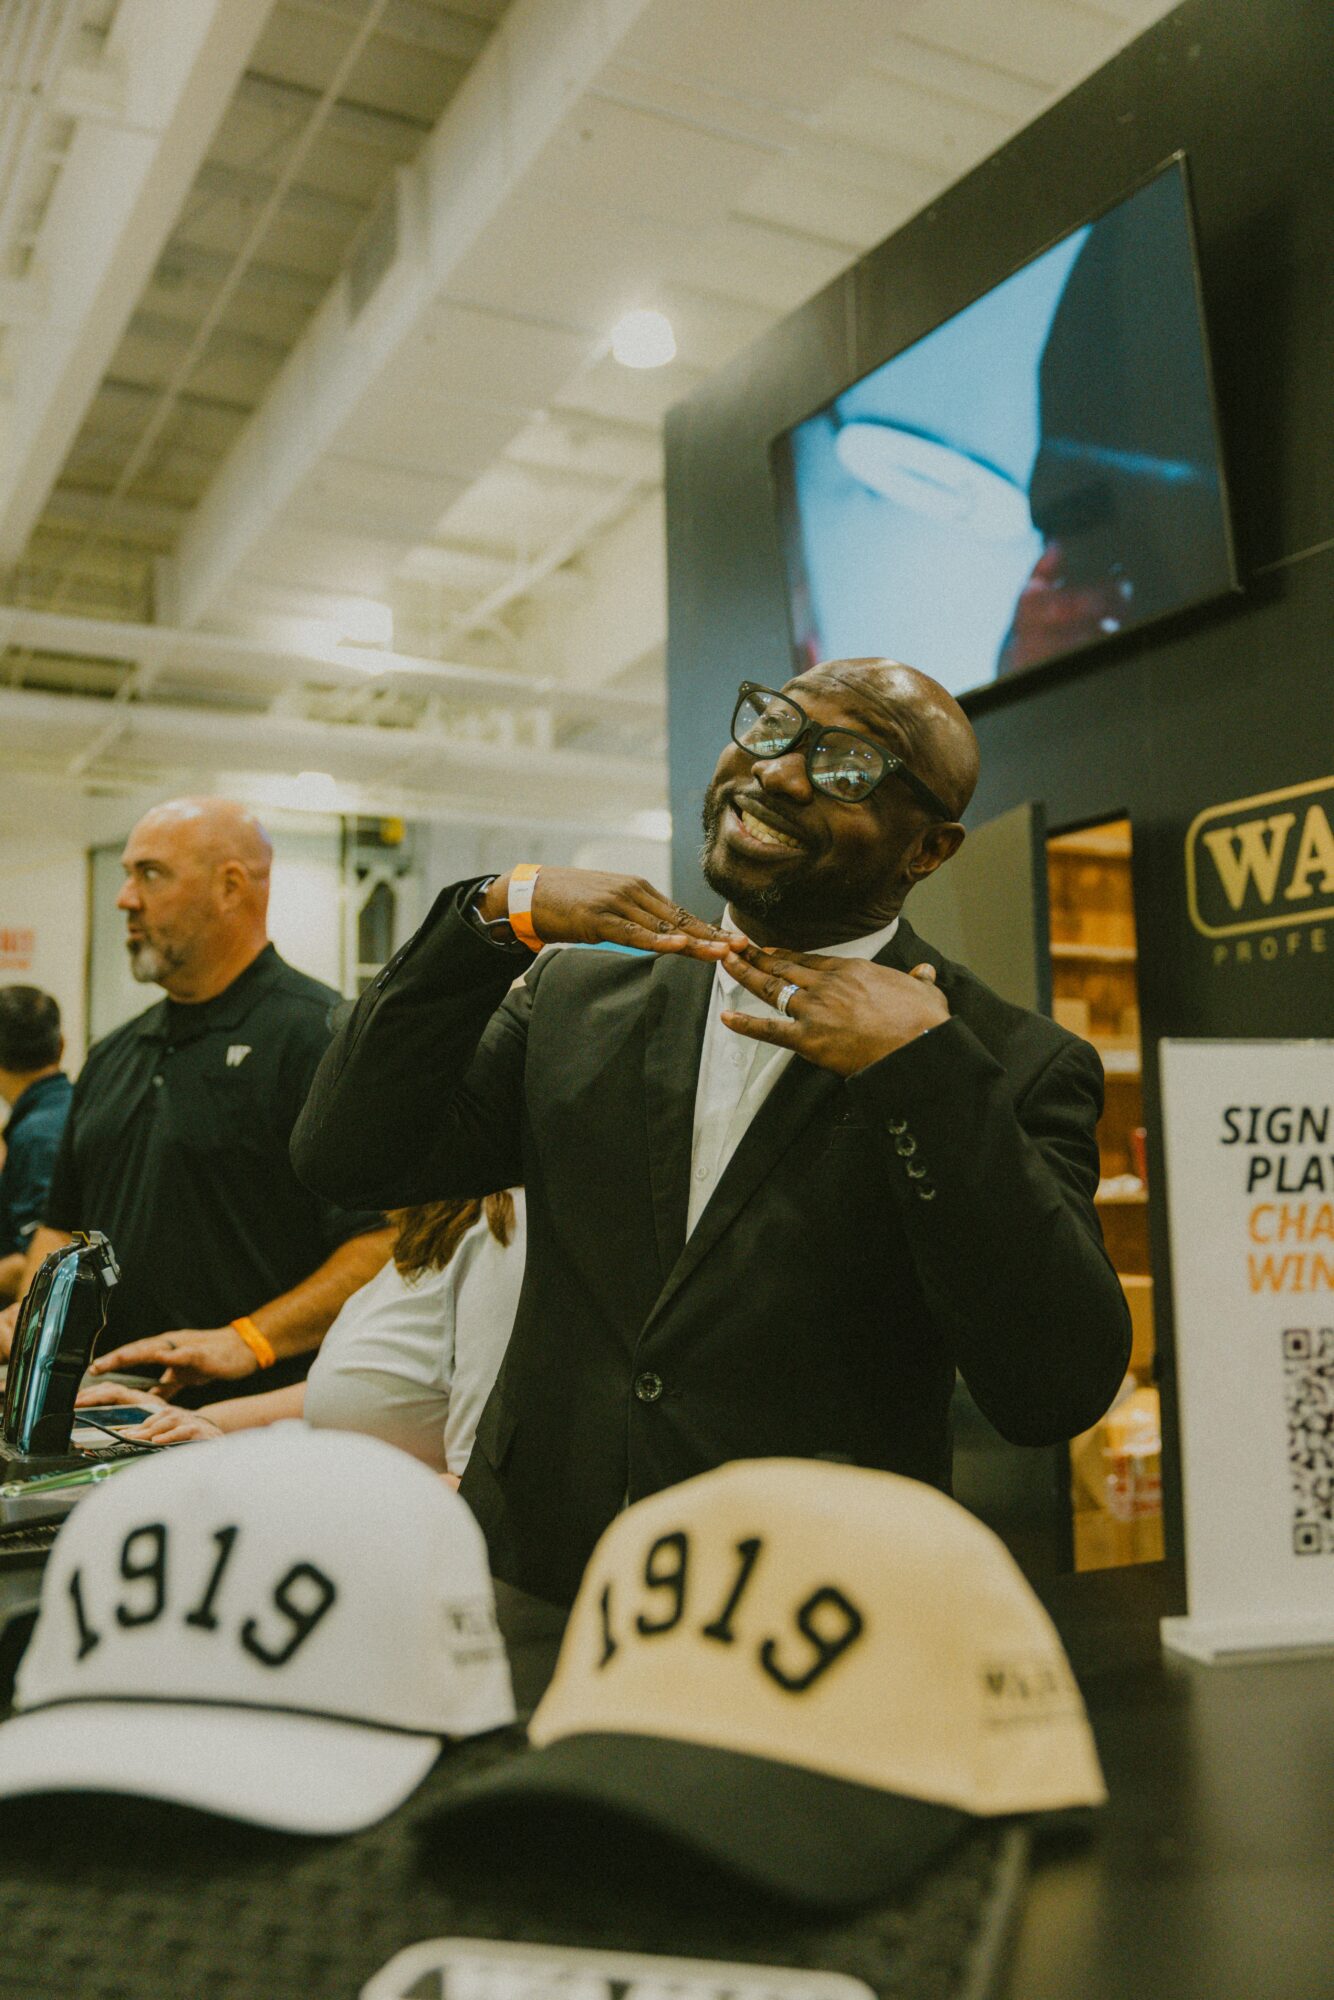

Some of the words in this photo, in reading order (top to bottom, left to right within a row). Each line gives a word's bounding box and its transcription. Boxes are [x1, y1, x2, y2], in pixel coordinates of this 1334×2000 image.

[1220, 1106, 1329, 1145] SIGN
[1247, 1155, 1334, 1193] PLA
[68, 1522, 339, 1667] 1919
[597, 1530, 864, 1693] 1919
